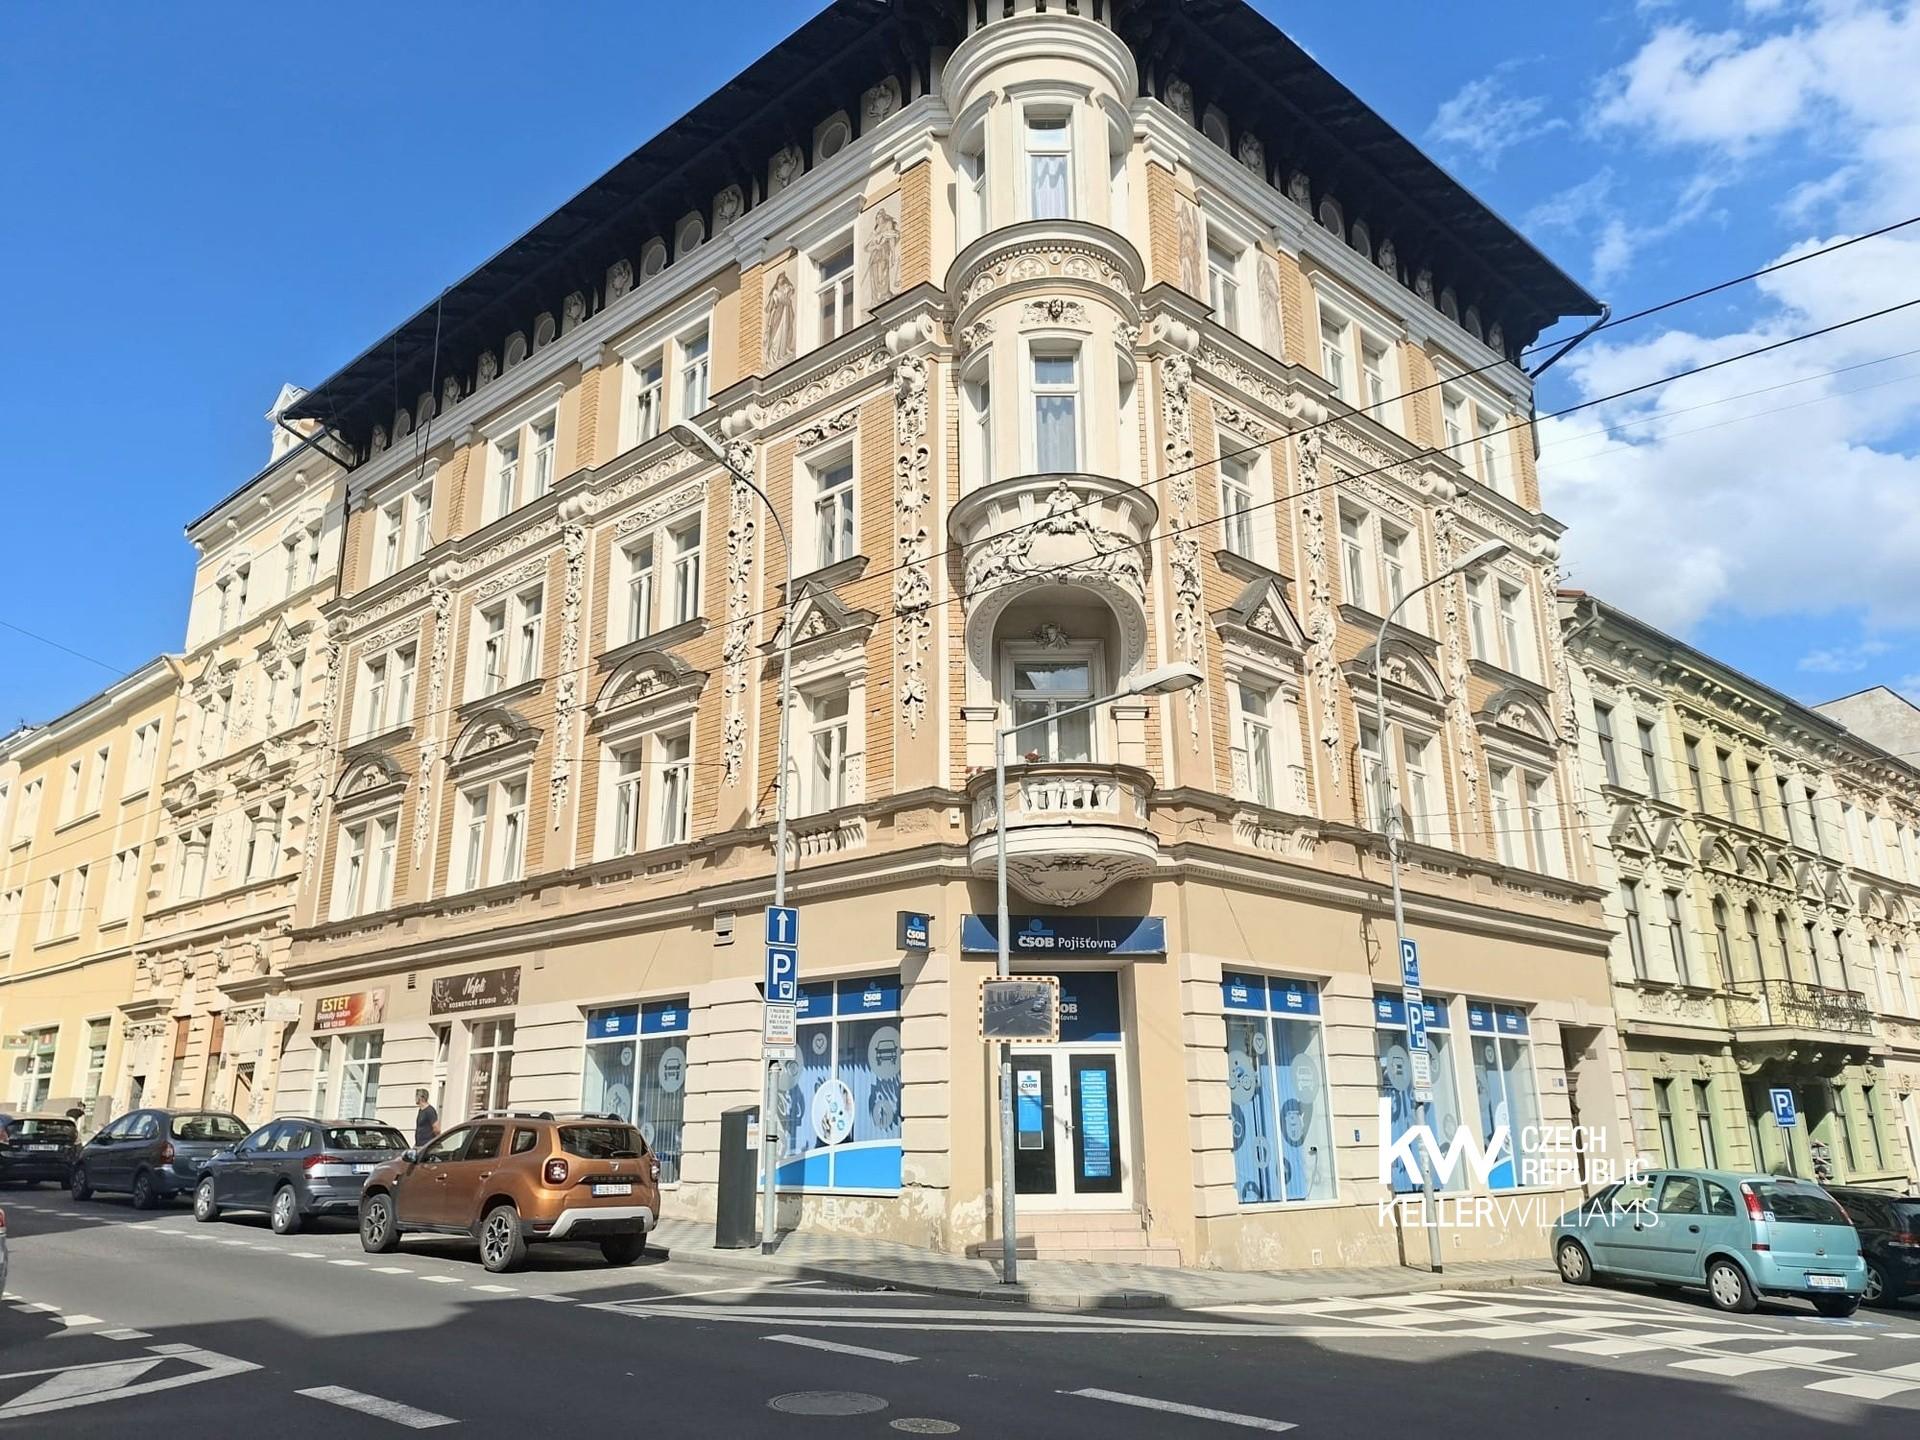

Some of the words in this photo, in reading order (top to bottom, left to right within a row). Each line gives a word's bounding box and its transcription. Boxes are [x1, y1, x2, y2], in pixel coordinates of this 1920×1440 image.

[907, 929, 926, 940] ČSOB
[1018, 935, 1055, 948] ČSOB
[1058, 937, 1118, 951] Pojišťovna
[1403, 944, 1415, 972] P
[772, 953, 791, 985] P
[322, 996, 351, 1013] ESTET
[479, 997, 497, 1005] STUDIO
[796, 999, 809, 1008] SOB
[1060, 1003, 1078, 1014] OB
[316, 1012, 336, 1022] Beauty
[336, 1010, 352, 1018] salon
[1410, 1006, 1422, 1034] P
[1021, 1081, 1038, 1089] ČSOB
[1775, 1093, 1789, 1115] P
